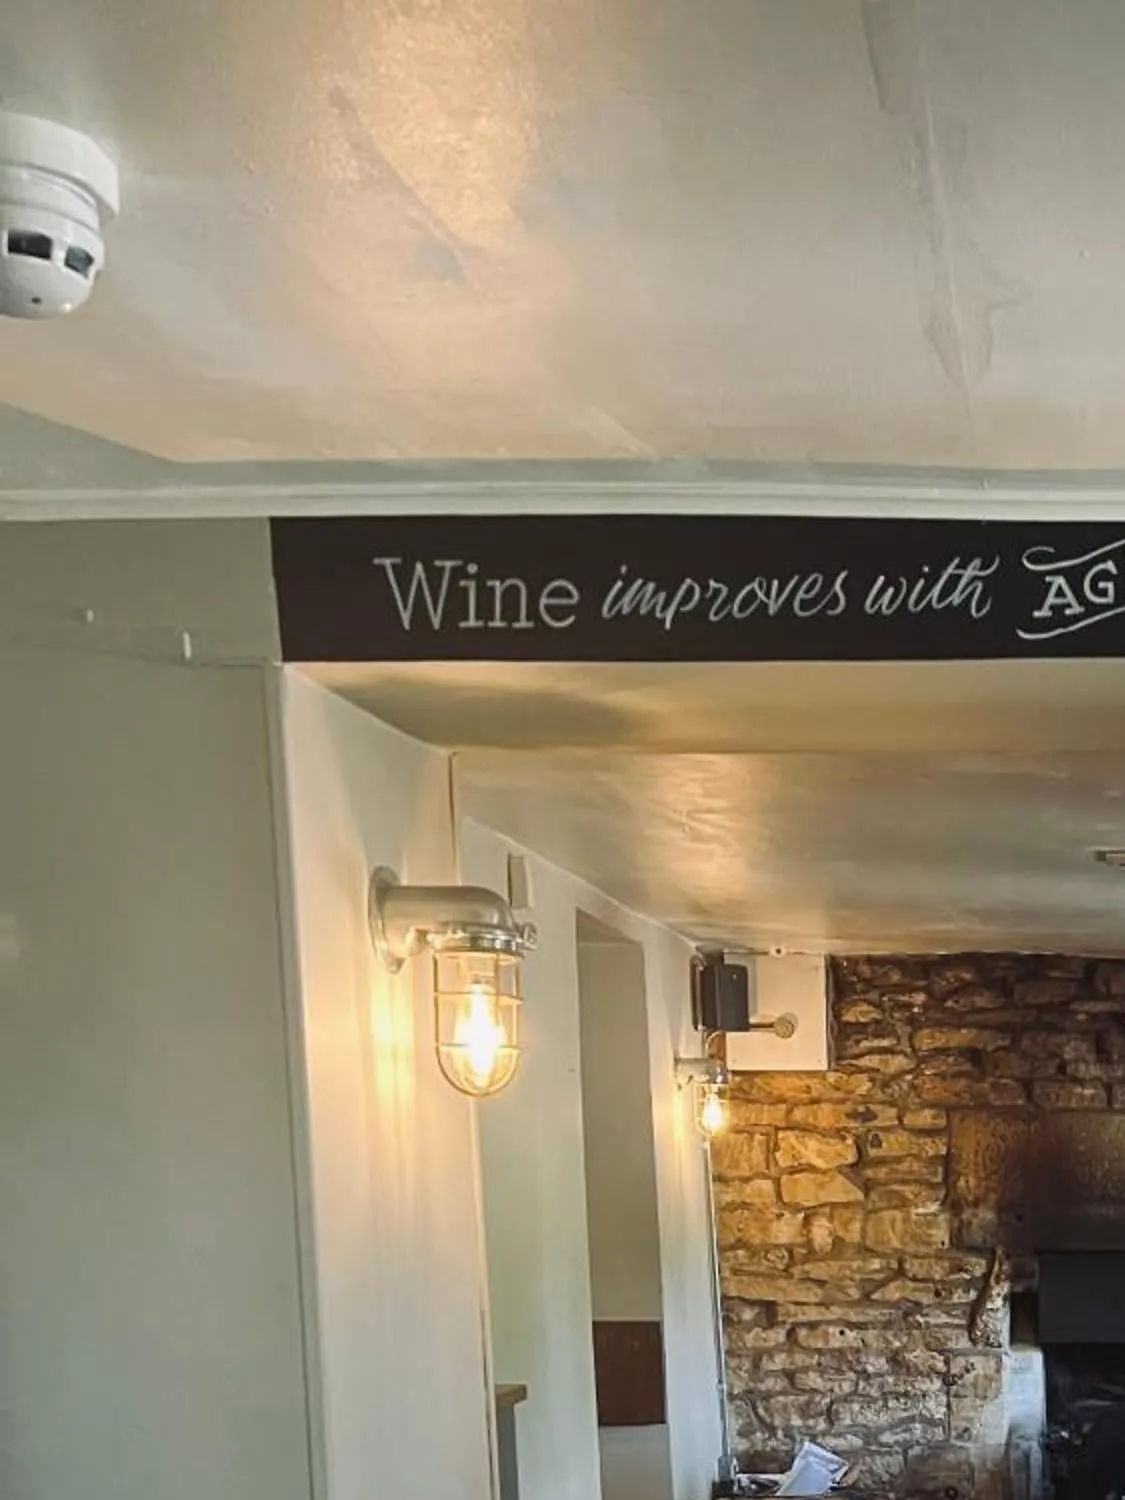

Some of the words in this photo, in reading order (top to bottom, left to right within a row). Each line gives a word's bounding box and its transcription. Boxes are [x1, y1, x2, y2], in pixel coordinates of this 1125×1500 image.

[373, 557, 578, 630] Wine
[601, 564, 849, 631] improves
[864, 555, 1000, 620] with
